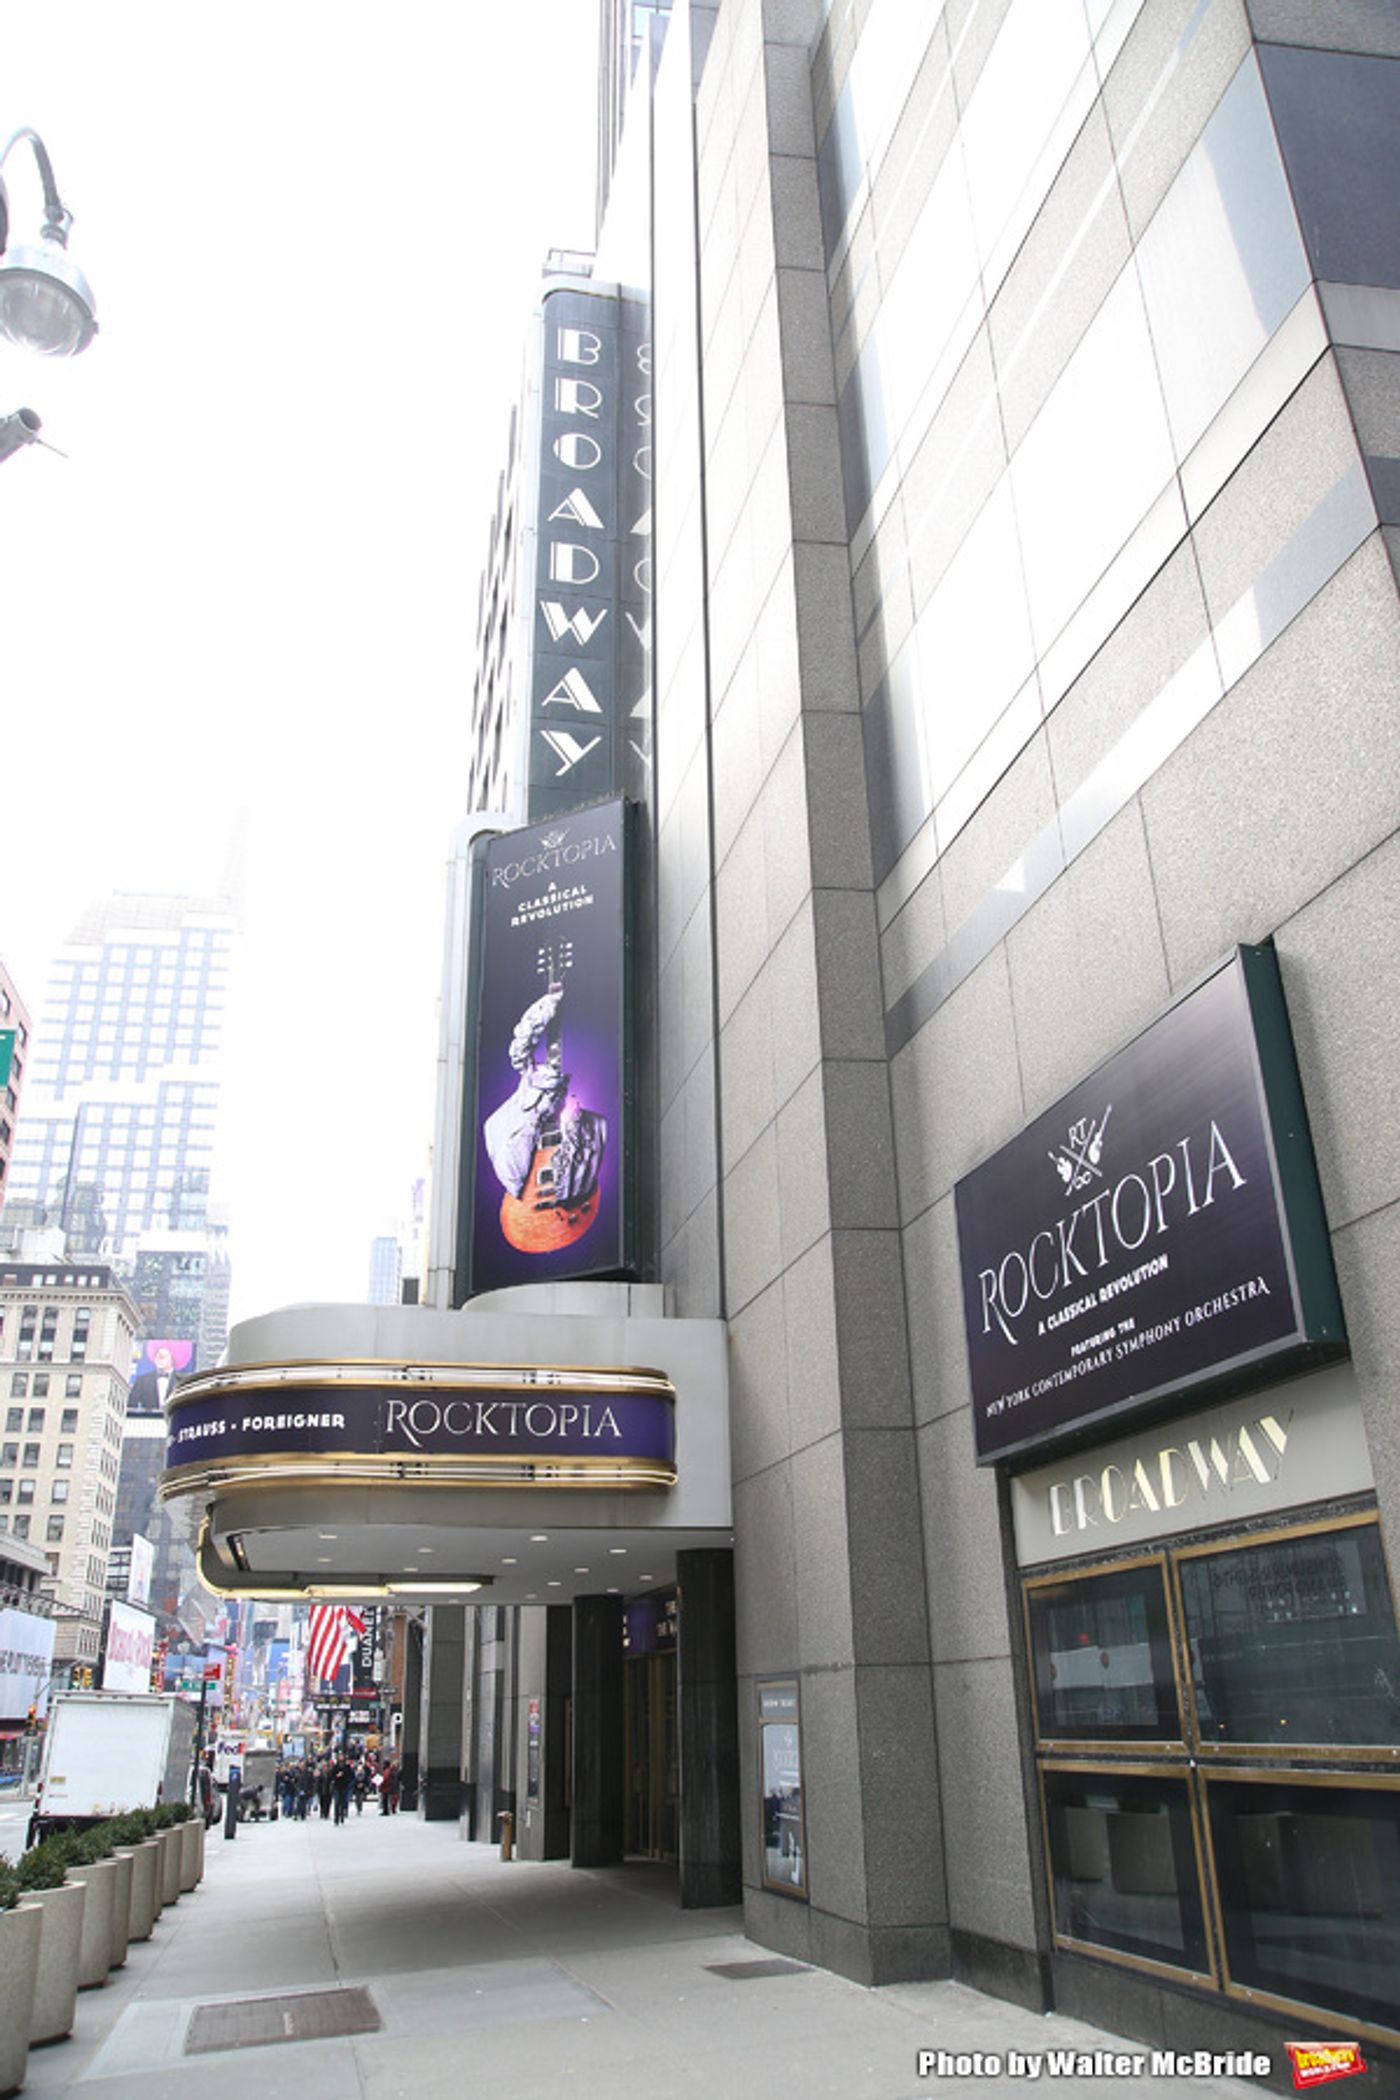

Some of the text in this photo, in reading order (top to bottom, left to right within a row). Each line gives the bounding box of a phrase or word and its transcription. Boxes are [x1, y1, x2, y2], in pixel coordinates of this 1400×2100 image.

[540, 328, 607, 777] BROADWAY
[492, 834, 616, 889] ROCKTOPIA
[548, 881, 556, 892] A
[510, 894, 594, 927] REVOLUTION
[518, 884, 587, 912] CLASSICAL
[978, 1120, 1248, 1346] ROCKTOPIA
[1037, 1253, 1169, 1336] A CLASSICAL REVOLUTION
[986, 1276, 1271, 1418] NEW YORK CONTEMPORARY SYMPHONY ORCHESTRA
[177, 1419, 226, 1444] STRAUSS
[242, 1412, 346, 1432] FOREIGNER
[385, 1399, 623, 1448] ROCKTOPIA
[1048, 1407, 1296, 1537] BROADWAY
